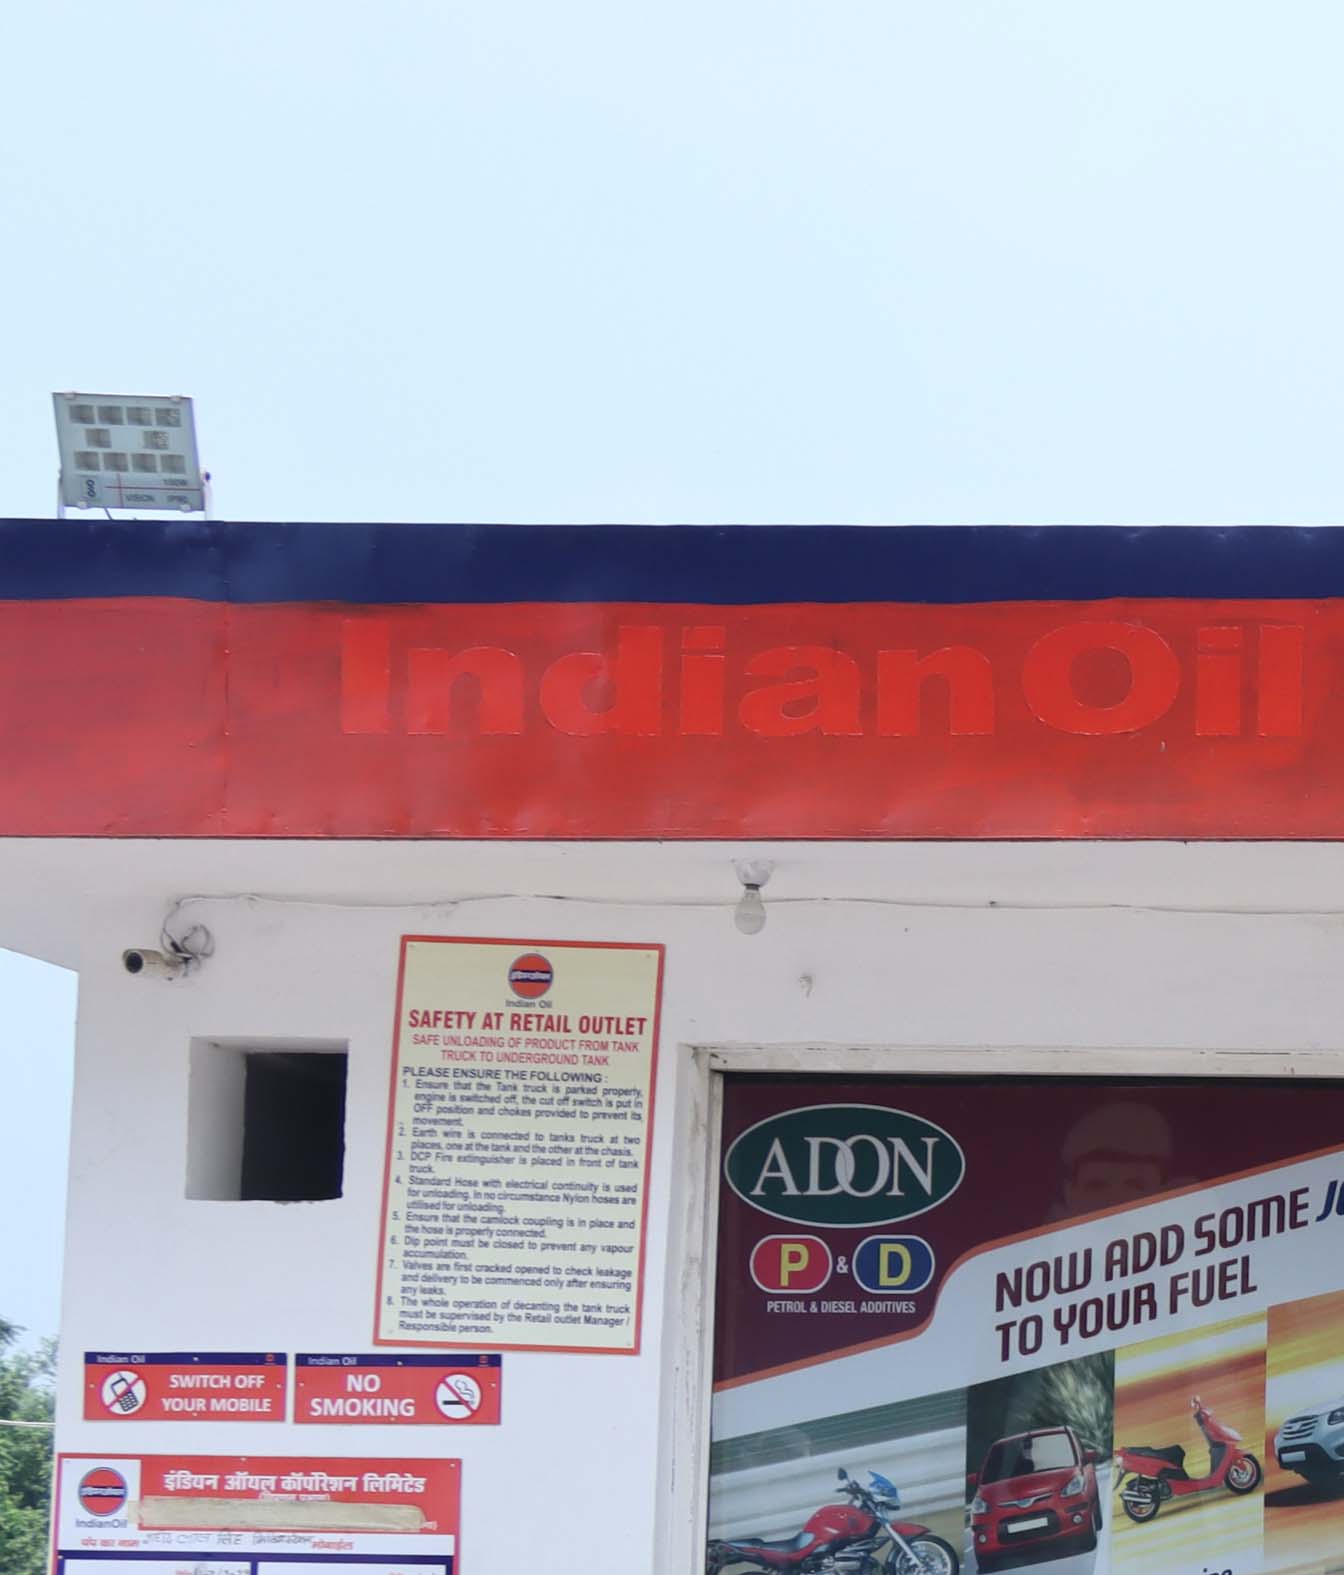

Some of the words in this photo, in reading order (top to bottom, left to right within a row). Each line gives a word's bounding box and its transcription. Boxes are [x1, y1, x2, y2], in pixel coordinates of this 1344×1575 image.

[341, 619, 995, 737] Indian
[1022, 619, 1305, 737] Oil
[505, 1000, 536, 1009] Indian
[538, 1000, 553, 1009] Oil
[408, 1010, 476, 1029] SAFETY
[481, 1012, 505, 1031] AT
[510, 1013, 571, 1033] RETAIL
[579, 1016, 647, 1035] OUTLET
[413, 1034, 440, 1046] SAFE
[443, 1035, 504, 1048] UNLOADING
[508, 1037, 522, 1049] OF
[524, 1038, 576, 1050] PRODUCT
[579, 1040, 609, 1051] FROM
[611, 1041, 639, 1052] TANK
[440, 1050, 477, 1062] TRUCK
[479, 1052, 493, 1062] TO
[496, 1053, 579, 1065] UNDERGROUND
[582, 1054, 609, 1066] TANK
[403, 1067, 450, 1078] PLEASE
[453, 1068, 500, 1079] ENSURE
[504, 1070, 527, 1080] THE
[530, 1071, 602, 1083] FOLLOWING
[750, 1134, 940, 1197] ADON
[995, 1248, 1092, 1312] NOW
[1105, 1224, 1184, 1282] ADD
[1195, 1187, 1310, 1257] SOME
[780, 1244, 809, 1287] P
[836, 1256, 849, 1274] &
[879, 1244, 911, 1286] D
[767, 1301, 807, 1313] PETROL
[810, 1302, 818, 1313] &
[821, 1301, 857, 1313] DIESEL
[860, 1301, 915, 1313] ADDITIVES
[995, 1315, 1043, 1362] TO
[1054, 1282, 1157, 1346] YOUR
[1169, 1254, 1257, 1314] FUEL
[97, 1355, 128, 1363] Indian
[131, 1355, 145, 1363] Oil
[308, 1357, 339, 1365] Indian
[342, 1357, 357, 1365] Oil
[169, 1375, 230, 1389] SWITCH
[235, 1375, 265, 1389] OFF
[346, 1374, 381, 1392] NO
[162, 1398, 207, 1412] YOUR
[211, 1399, 271, 1412] MOBILE
[310, 1398, 415, 1416] SMOKING
[75, 1519, 128, 1528] IndianOil
